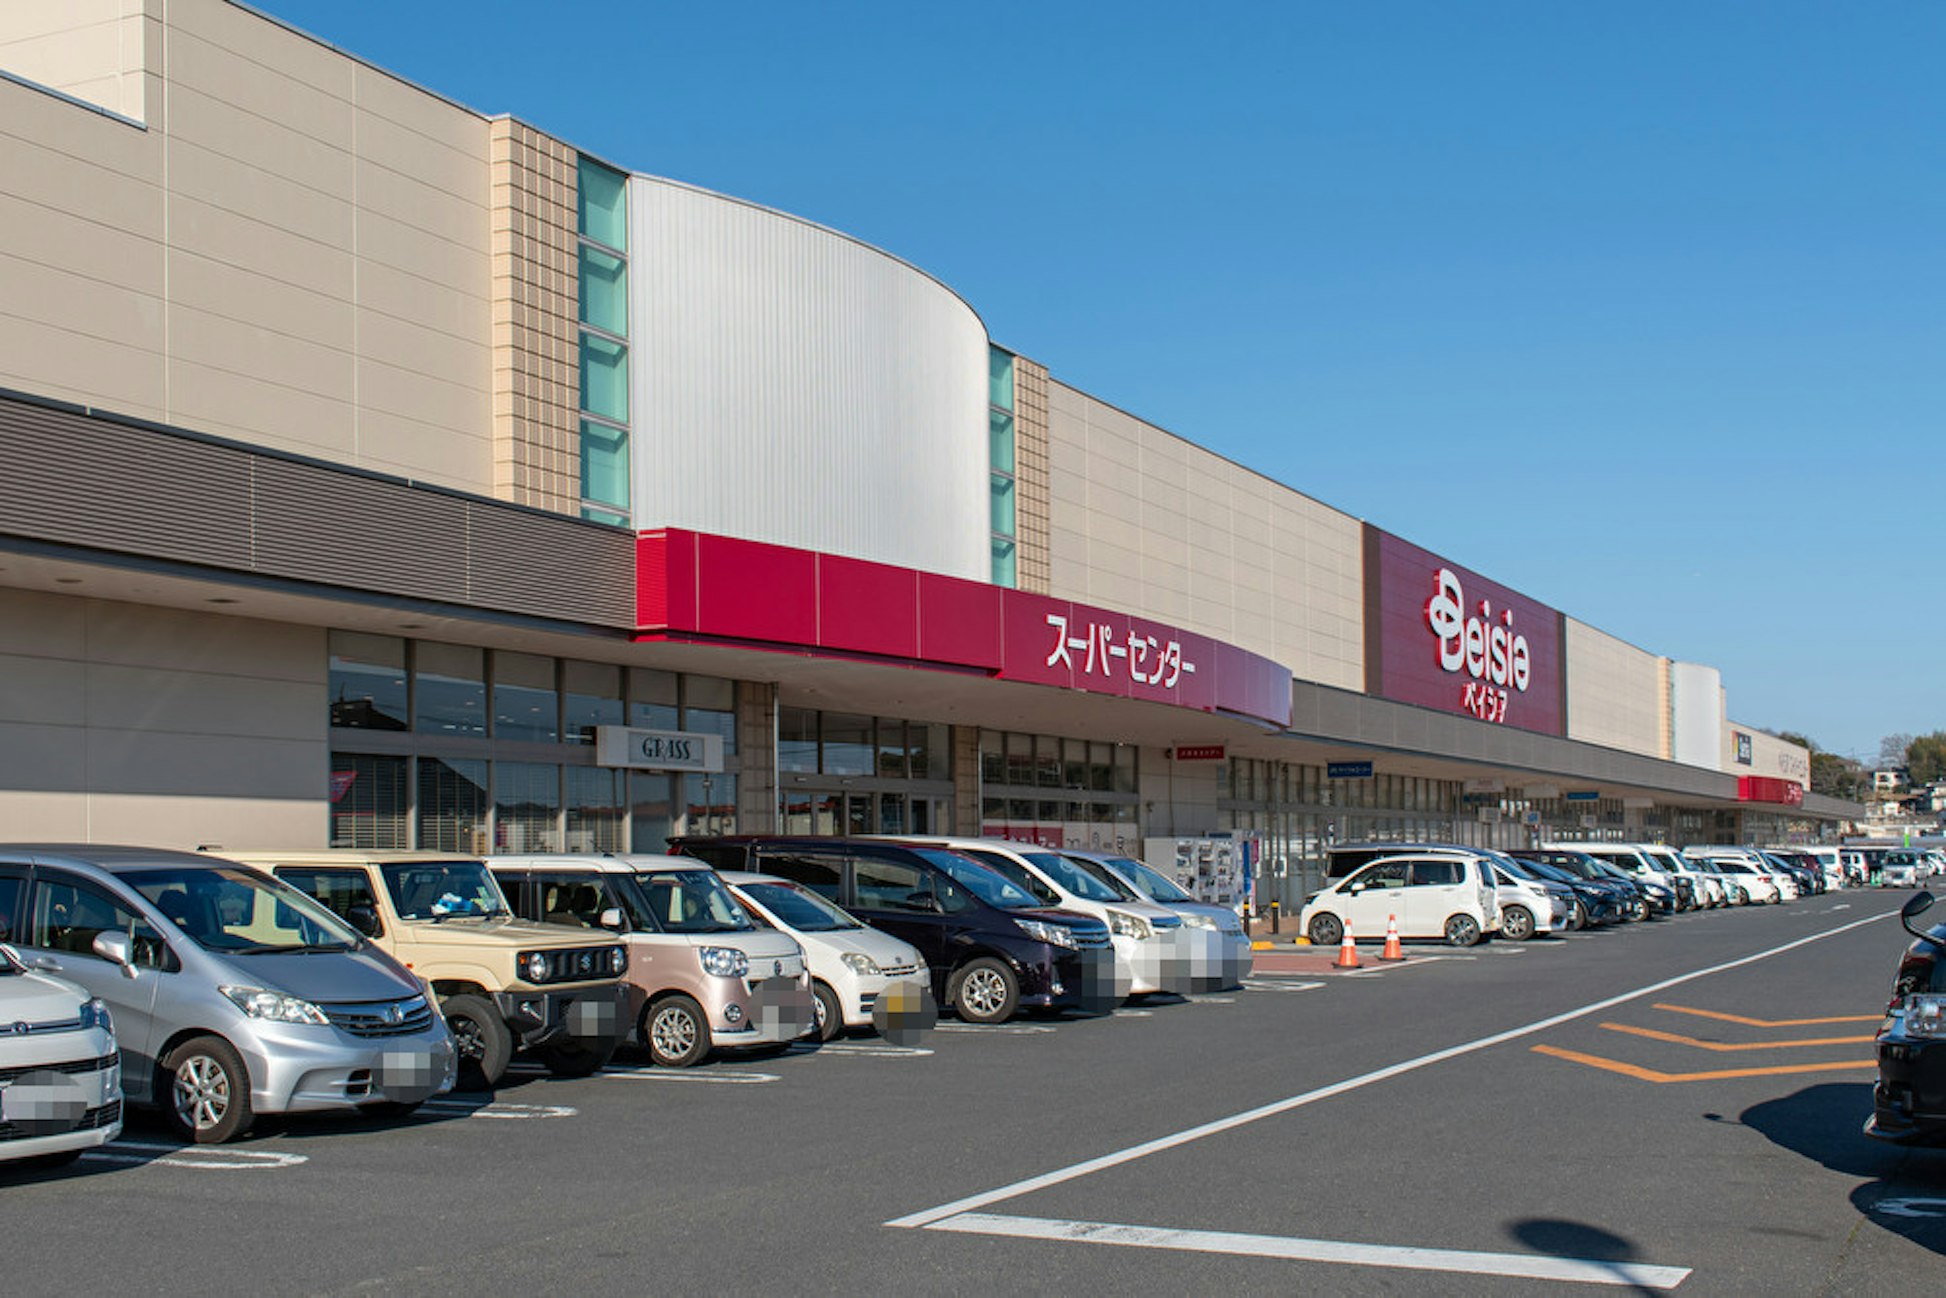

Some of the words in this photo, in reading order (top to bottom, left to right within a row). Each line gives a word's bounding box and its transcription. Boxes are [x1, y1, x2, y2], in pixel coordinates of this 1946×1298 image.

[1046, 613, 1196, 689] スーパーセンター
[1426, 567, 1531, 692] Beisia
[641, 736, 692, 762] GRASS
